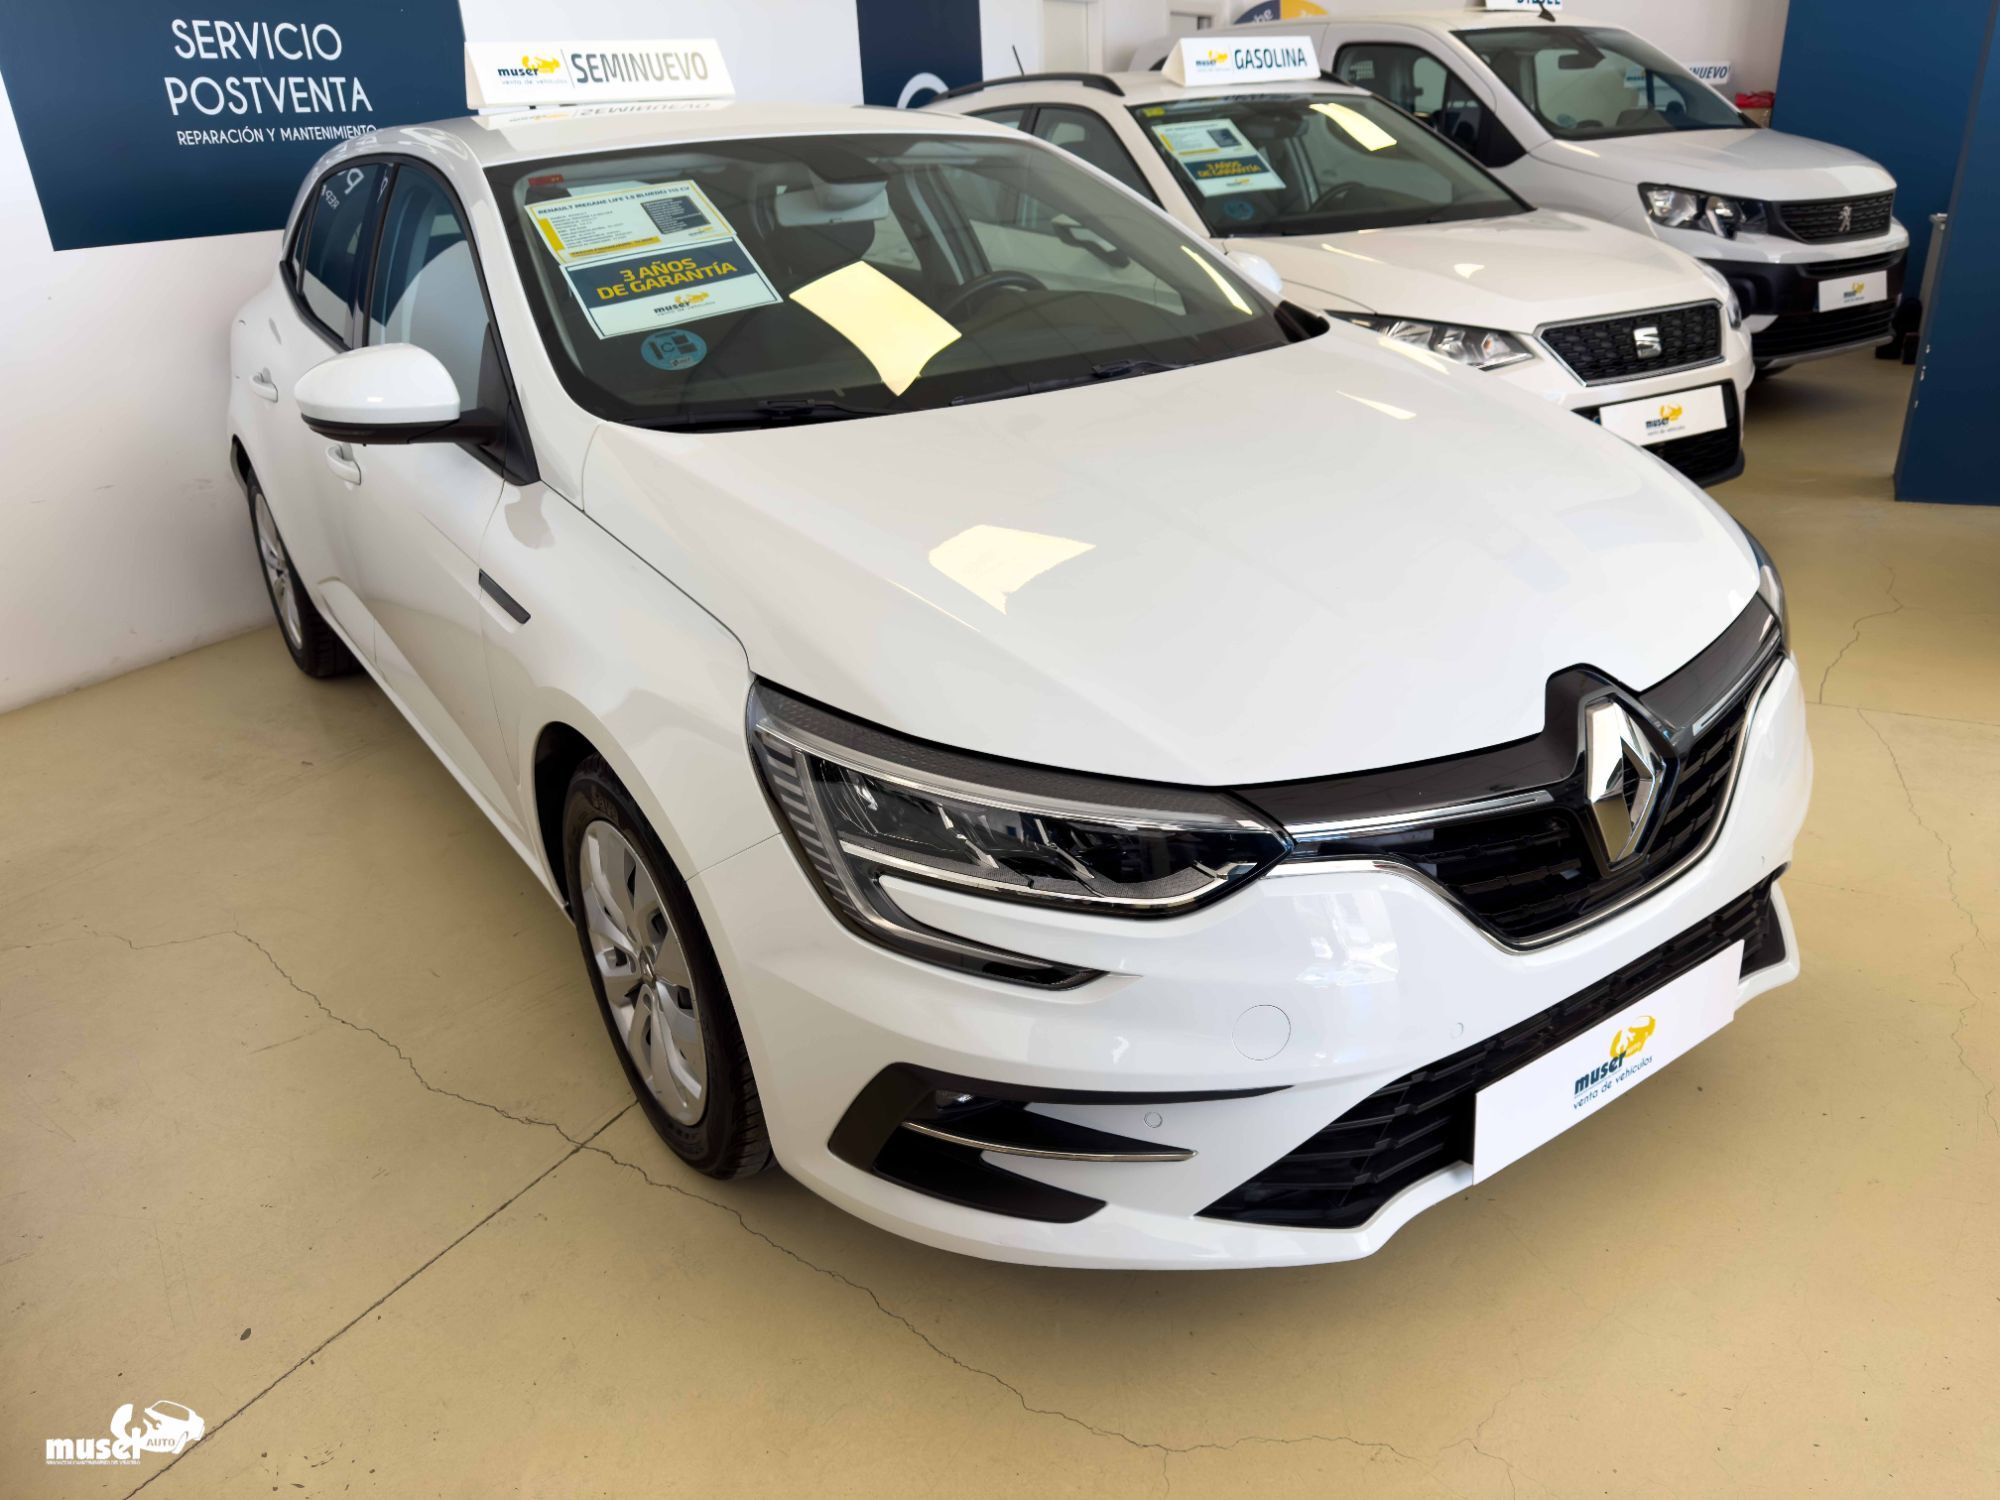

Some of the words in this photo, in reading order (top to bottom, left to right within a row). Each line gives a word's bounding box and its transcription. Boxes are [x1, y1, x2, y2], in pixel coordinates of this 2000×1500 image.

[171, 18, 343, 61] SERVICIO
[497, 67, 540, 77] muser
[570, 52, 709, 84] SEMINUEVO
[1234, 48, 1308, 70] GASOLINA
[1689, 66, 1728, 79] NUEVO
[163, 76, 373, 116] POSTVENTA
[176, 126, 265, 146] REPARACIÓN
[266, 128, 275, 143] Y
[596, 283, 629, 300] DE
[630, 262, 738, 294] GARANTÍA
[620, 269, 636, 283] 3
[638, 257, 698, 280] AÑOS
[653, 301, 690, 314] muser
[1574, 1050, 1627, 1095] muser
[1573, 1090, 1599, 1110] venta
[1601, 1080, 1613, 1093] de
